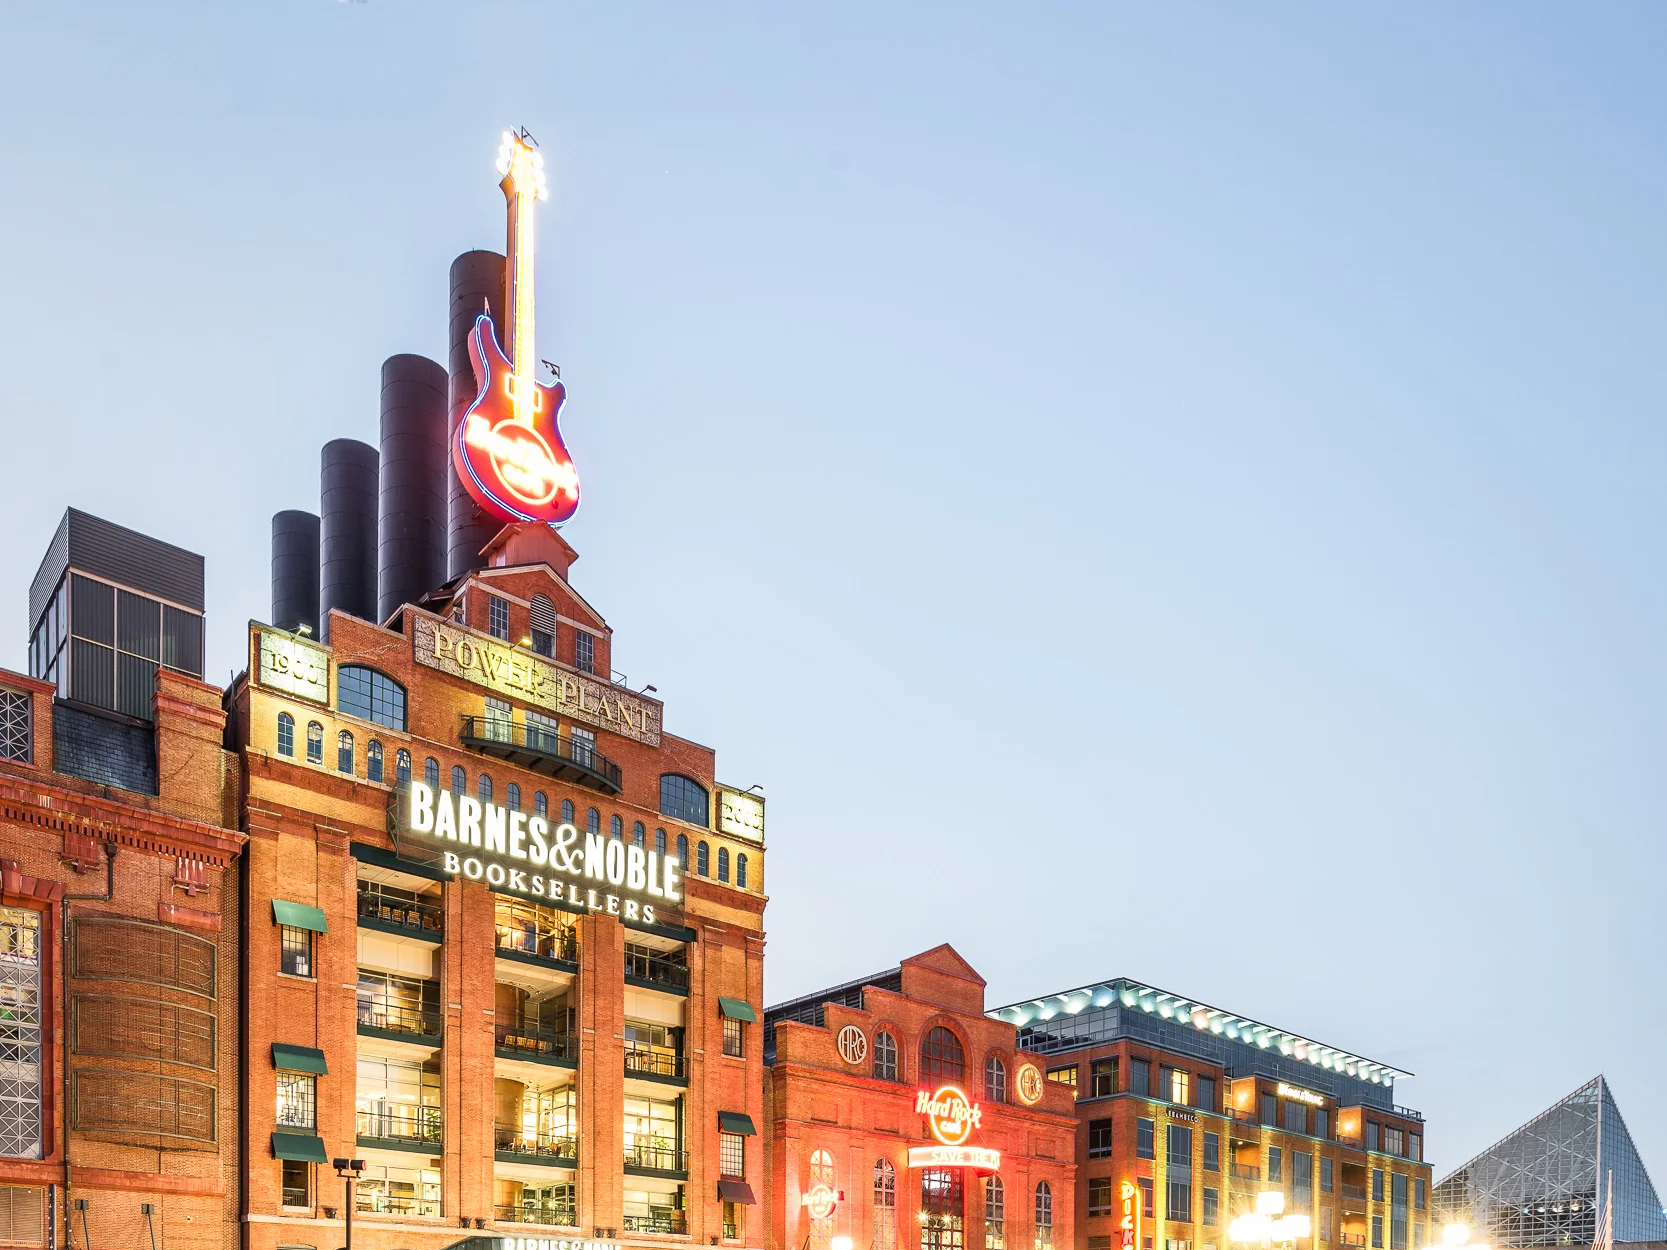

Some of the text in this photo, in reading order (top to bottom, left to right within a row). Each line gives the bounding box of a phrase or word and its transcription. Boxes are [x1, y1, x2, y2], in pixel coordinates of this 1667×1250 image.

[432, 627, 653, 734] POWER PLANT
[443, 851, 655, 924] BOOKSELLERS
[916, 1091, 982, 1129] Hard Rock
[931, 1151, 965, 1163] SAVE
